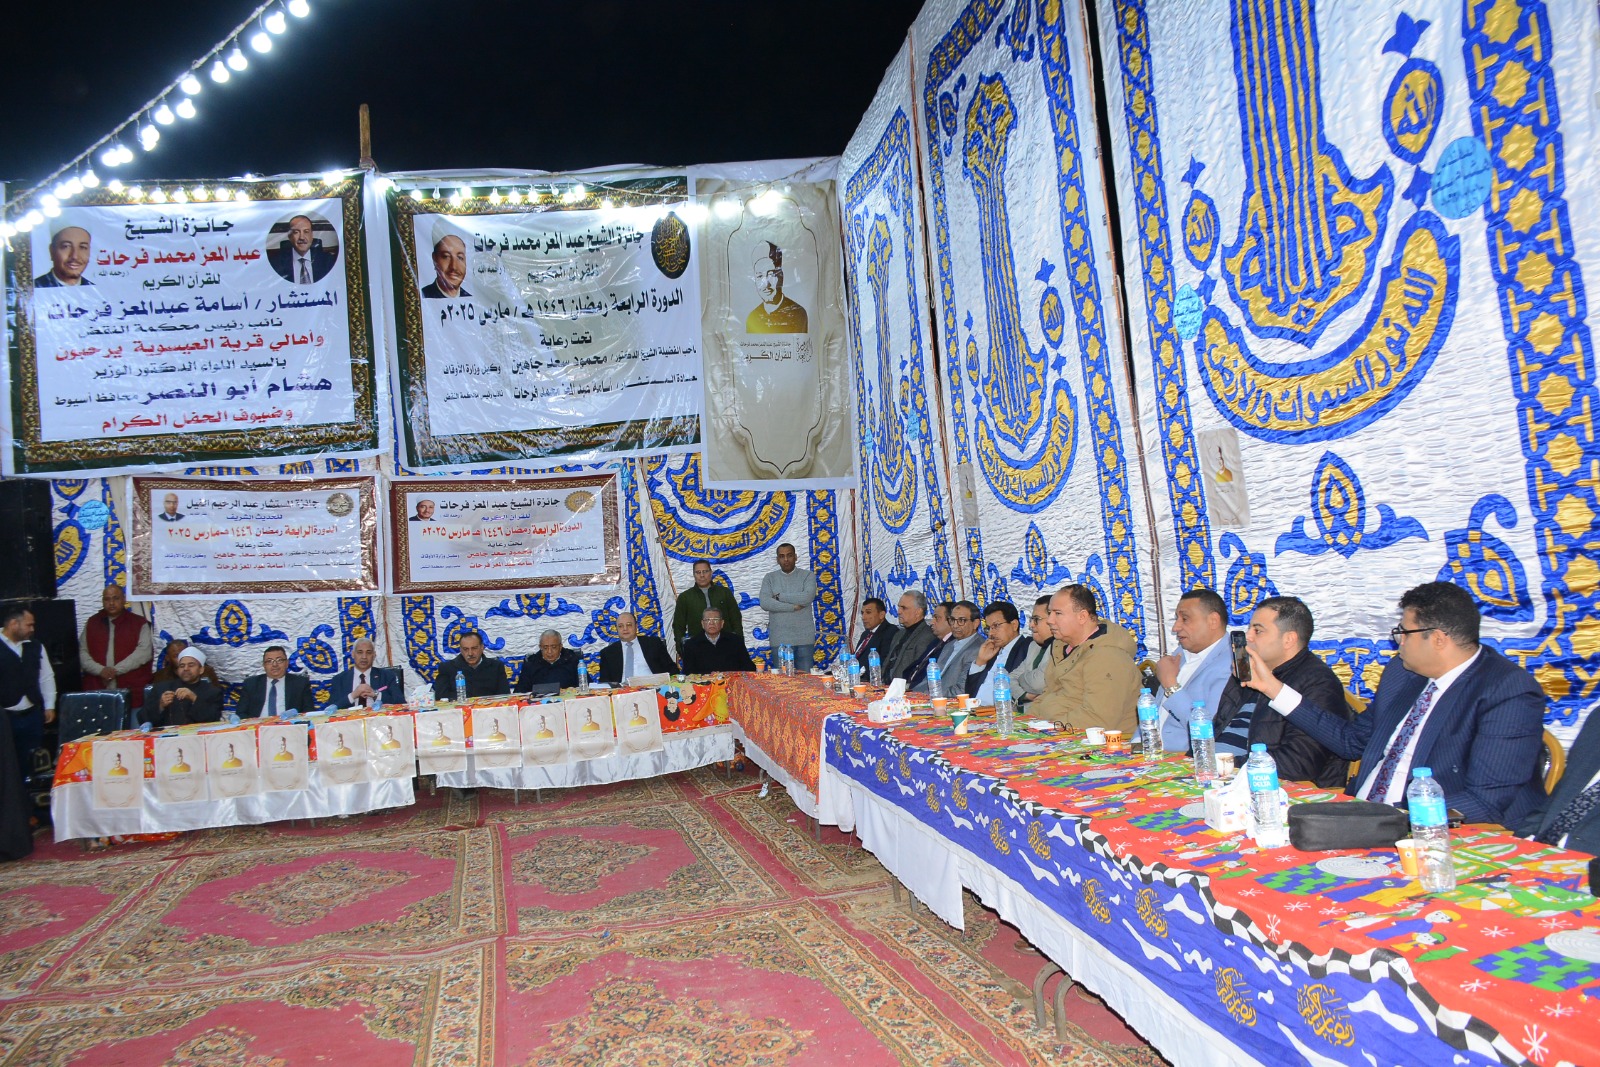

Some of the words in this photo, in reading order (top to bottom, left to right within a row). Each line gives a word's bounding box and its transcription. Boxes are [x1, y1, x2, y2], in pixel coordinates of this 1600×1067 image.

[125, 216, 178, 240] الشيخ
[182, 216, 234, 238] جائزة
[473, 230, 510, 257] فرحات
[512, 236, 541, 250] محمد
[543, 230, 563, 255] المعز
[565, 231, 585, 253] عبد
[587, 225, 615, 253] الشيخ
[616, 225, 645, 250] جائزة
[96, 248, 150, 269] فرحات
[154, 249, 196, 265] محمد
[200, 248, 229, 267] المعز
[233, 247, 261, 265] عبد
[142, 274, 185, 291] الكريم
[188, 273, 221, 289] للقرآن
[196, 292, 249, 312] أسامة
[255, 299, 261, 310] /
[266, 289, 338, 313] المستشار
[536, 298, 567, 315] ١٤٤٦
[570, 295, 610, 321] رمضان
[611, 290, 649, 314] الرابعة
[651, 287, 683, 313] الدورة
[47, 300, 113, 324] فرحات
[478, 302, 511, 326] مارس
[133, 323, 200, 334] محكمة
[204, 321, 244, 334] رئيس
[249, 317, 283, 329] نائب
[132, 337, 214, 355] العيسوية
[220, 333, 263, 351] قرية
[268, 329, 324, 352] وأهالي
[539, 332, 569, 349] رعاية
[570, 330, 592, 346] تحت
[640, 347, 657, 361] الشيخ
[658, 346, 681, 358] الفضيلة
[92, 364, 133, 380] الوزير
[137, 361, 197, 377] الدكتور
[443, 361, 465, 377] الأوقاف
[466, 363, 480, 376] وزارة
[512, 357, 543, 375] جاهين
[140, 380, 216, 405] النصر
[226, 375, 257, 401] أبو
[267, 373, 333, 399] هشام
[513, 385, 539, 402] فرحات
[54, 391, 93, 407] أسيوط
[173, 412, 228, 429] الحفل
[233, 405, 294, 424] وضيوف
[102, 415, 167, 433] الكرام
[242, 500, 259, 511] عبد
[440, 499, 470, 511] فرحات
[472, 499, 489, 511] المعز
[491, 500, 508, 511] عبد
[510, 497, 535, 511] الشيخ
[536, 497, 560, 508] جائزة
[167, 527, 191, 538] ٢٠٢٥
[231, 525, 253, 537] ١٤٤٦
[255, 525, 283, 537] رمضان
[448, 527, 471, 540] مارس
[483, 526, 504, 538] ١٤٤٦
[505, 525, 531, 537] رمضان
[531, 522, 559, 537] الرابعة
[1252, 773, 1271, 781] AQUA
